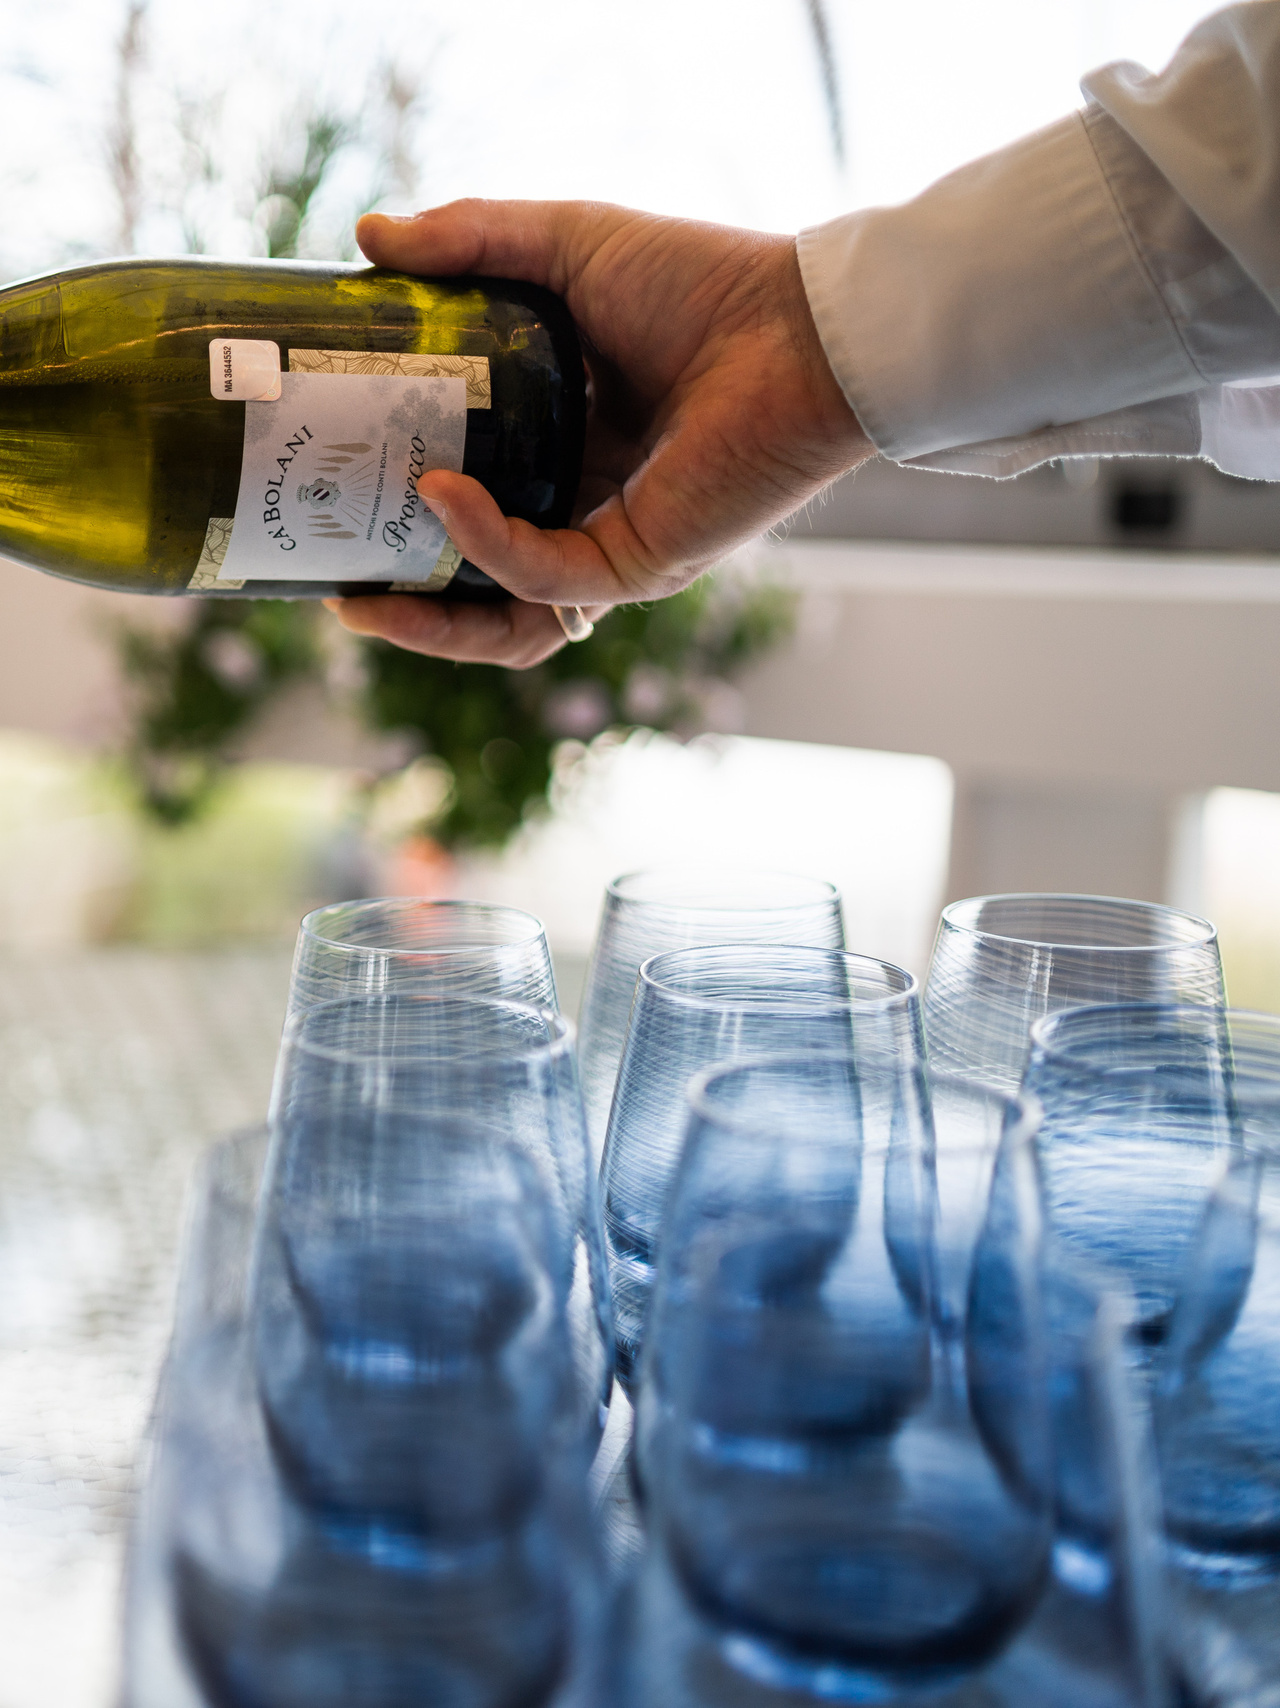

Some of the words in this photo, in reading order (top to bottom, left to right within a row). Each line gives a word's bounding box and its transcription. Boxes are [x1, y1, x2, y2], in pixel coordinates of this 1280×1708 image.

[223, 346, 233, 378] 3644552
[224, 379, 233, 393] MA
[380, 442, 388, 469] BOLANI
[376, 470, 386, 492] CONTI
[382, 429, 426, 553] Prosecco
[372, 493, 382, 516] PODERI
[366, 517, 377, 541] ANTICHI
